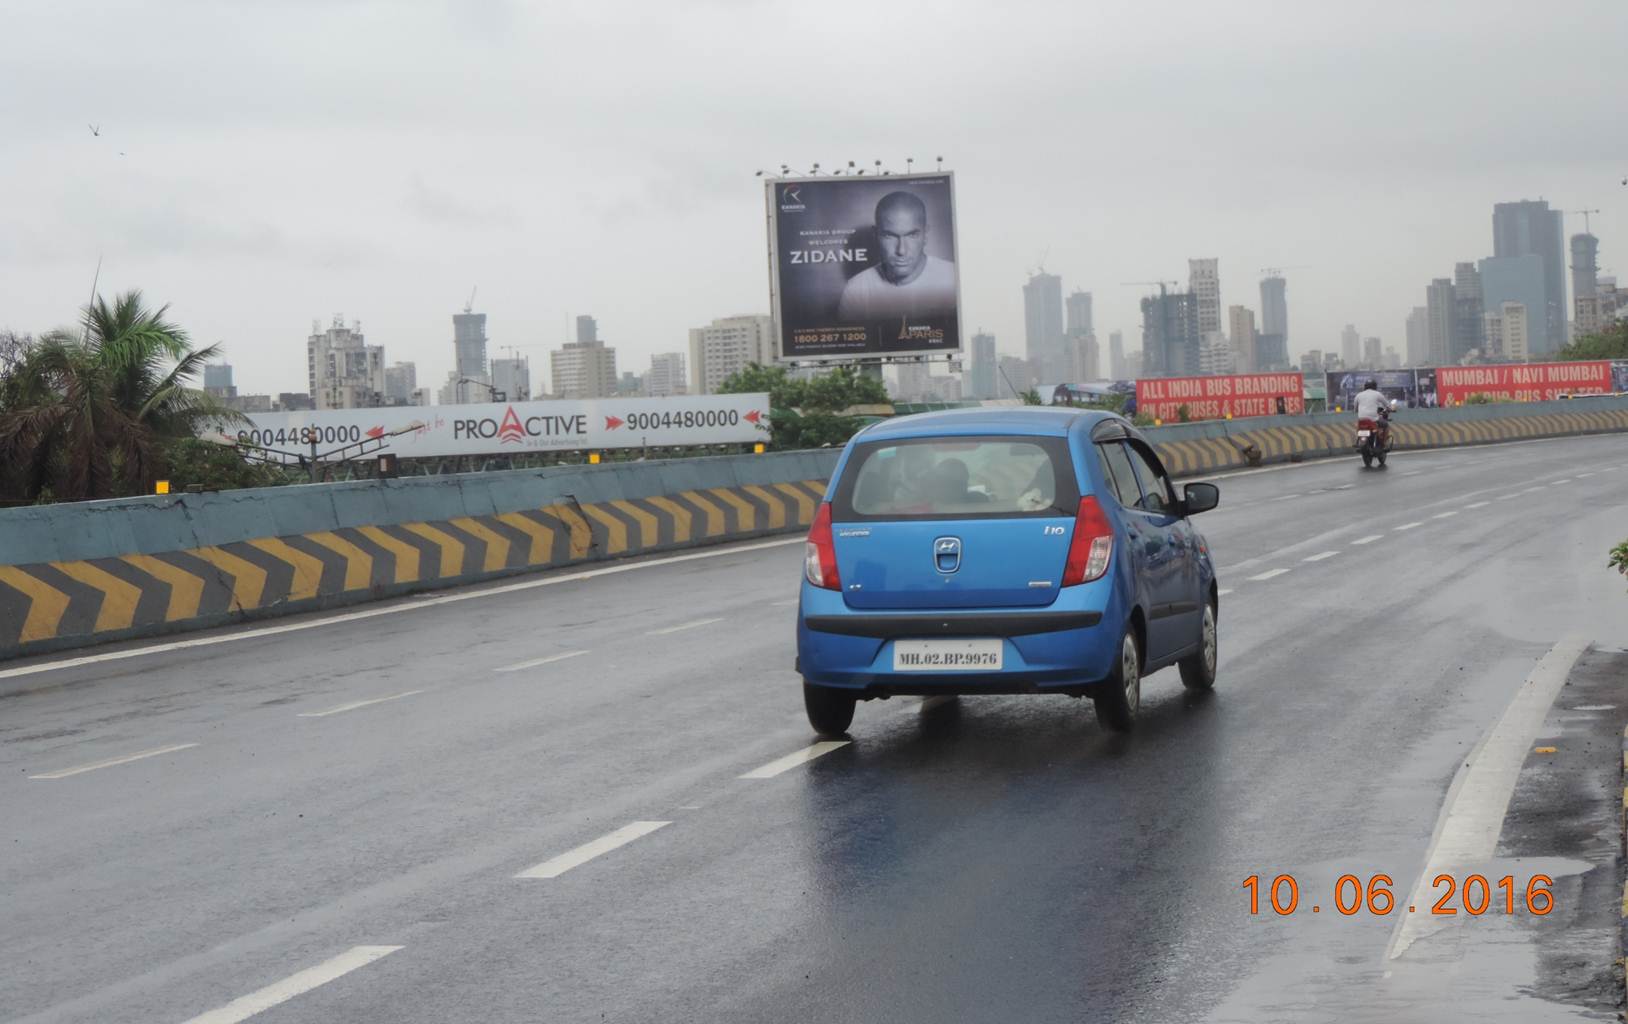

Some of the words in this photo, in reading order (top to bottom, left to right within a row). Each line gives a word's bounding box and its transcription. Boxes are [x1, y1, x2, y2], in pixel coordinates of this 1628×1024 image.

[790, 248, 868, 264] ZIDANE
[794, 334, 818, 344] 1800
[820, 333, 839, 343] 267
[842, 332, 866, 342] 1200
[1442, 369, 1498, 386] MUMBAI
[1512, 366, 1544, 384] NAVI
[1548, 364, 1603, 382] MUMBAI
[1142, 382, 1165, 399] ALL
[1168, 379, 1202, 398] INDIA
[1207, 378, 1231, 396] BUS
[1235, 375, 1299, 395] BRANDING
[1234, 397, 1265, 416] STATE
[454, 405, 588, 440] PROACTIVE
[627, 409, 739, 431] 9004480000
[899, 653, 997, 665] MH.02.BP.9976
